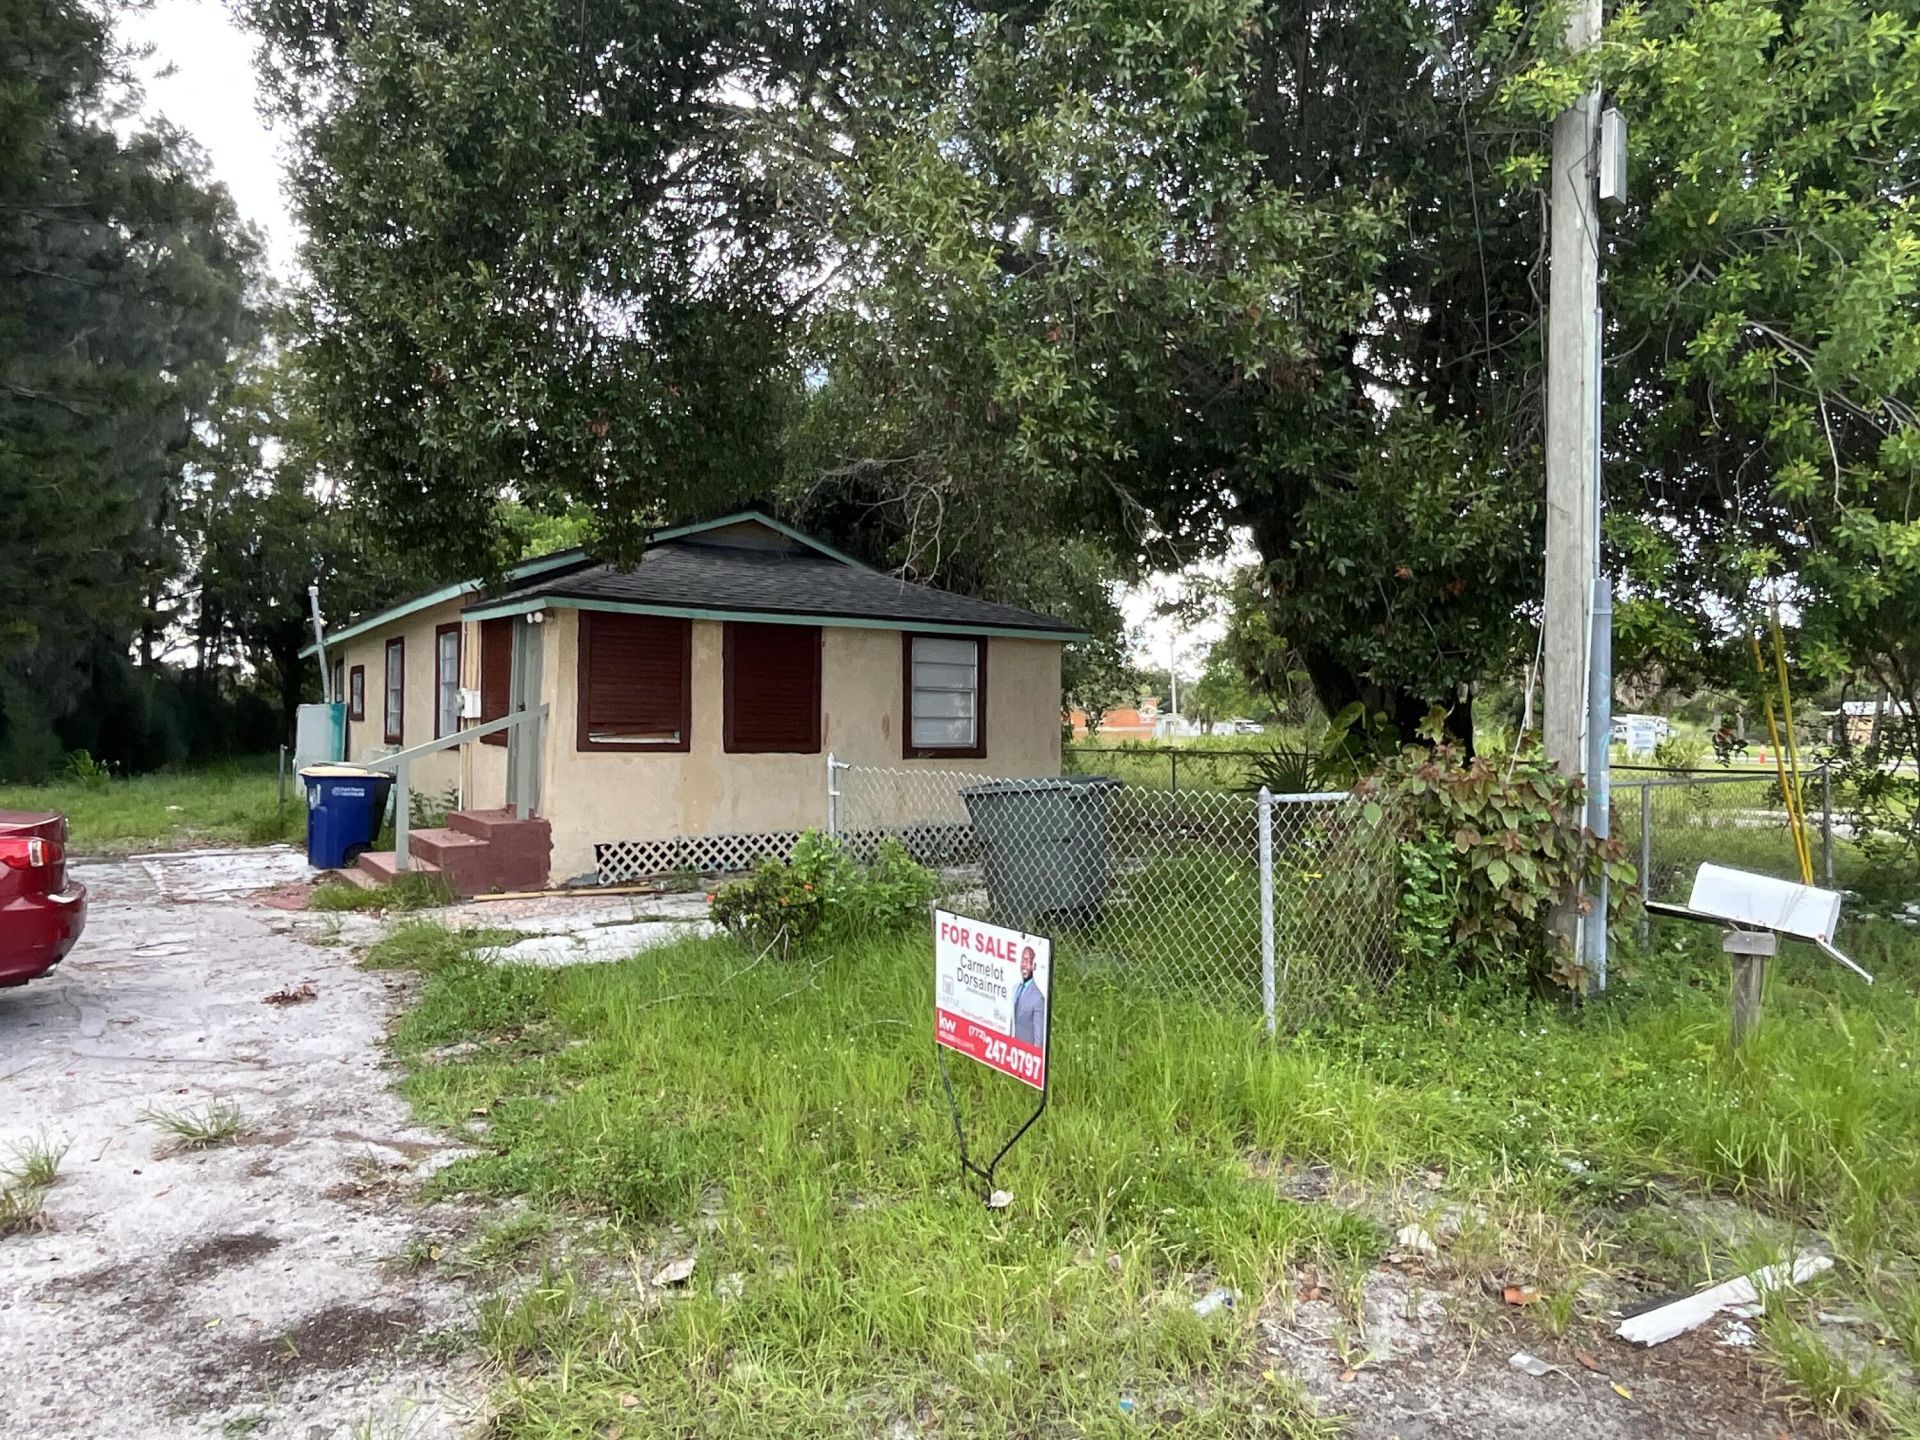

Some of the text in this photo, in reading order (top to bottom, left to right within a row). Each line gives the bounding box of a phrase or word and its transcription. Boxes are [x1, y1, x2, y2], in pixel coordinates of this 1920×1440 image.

[941, 922, 1017, 963] FOR SALE
[960, 954, 1004, 982] Carmelot
[984, 1035, 1042, 1080] 247-0797
